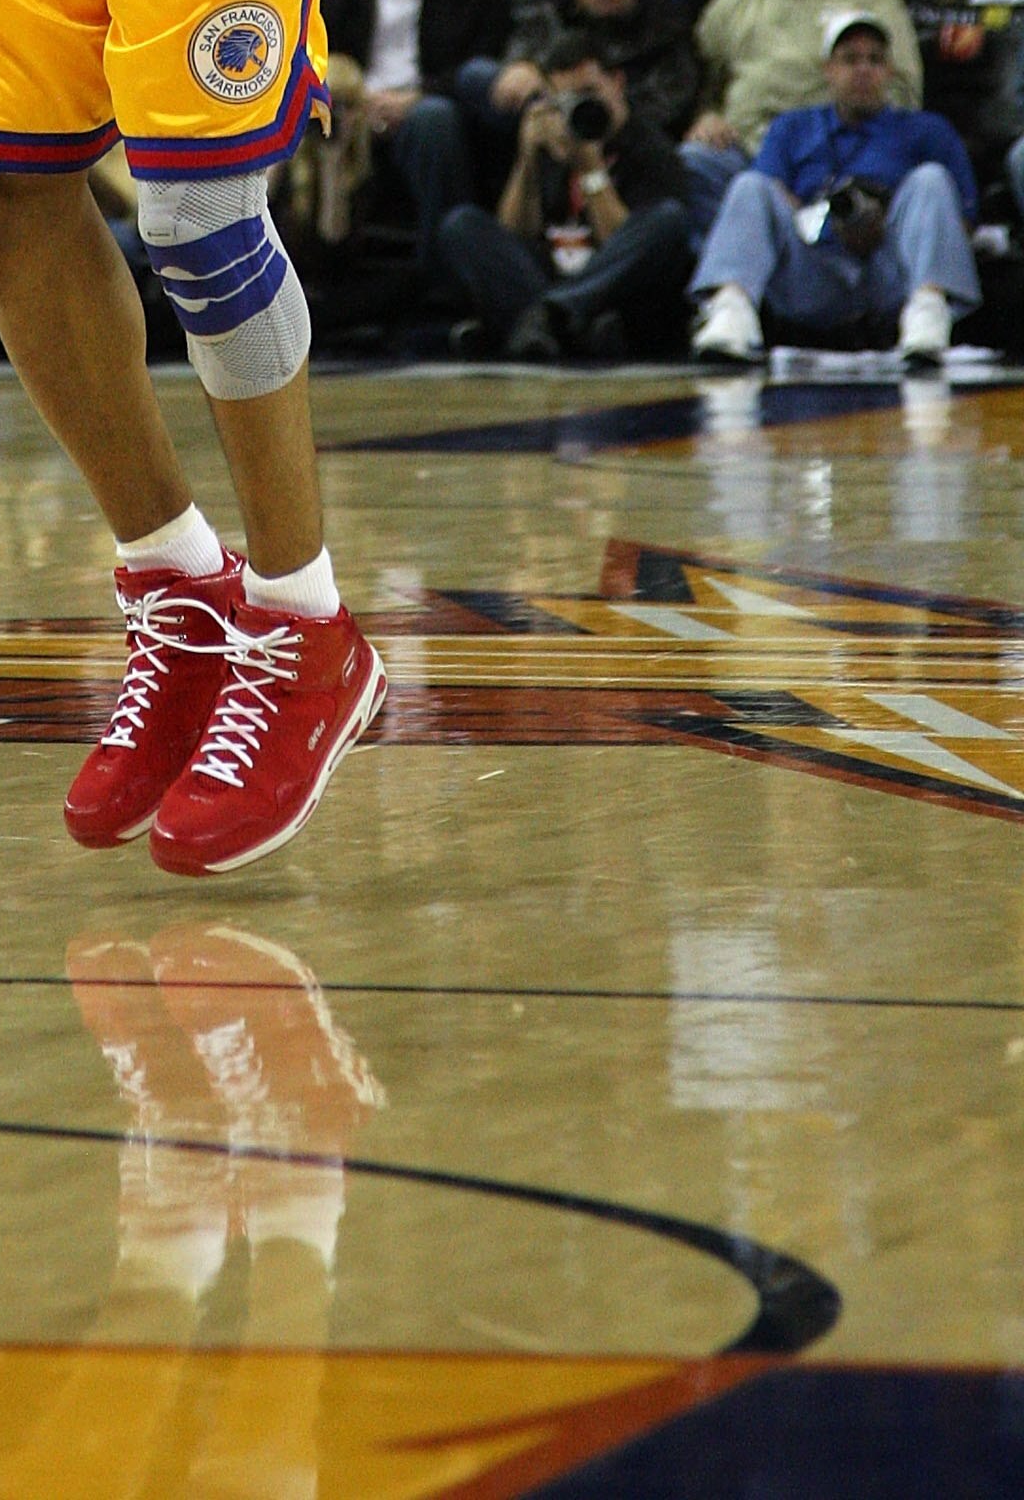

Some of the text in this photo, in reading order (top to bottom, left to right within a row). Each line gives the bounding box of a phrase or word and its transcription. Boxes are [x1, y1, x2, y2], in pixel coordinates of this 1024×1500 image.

[199, 9, 278, 53] SAN FRANCISCO
[205, 66, 273, 97] WARRIORS
